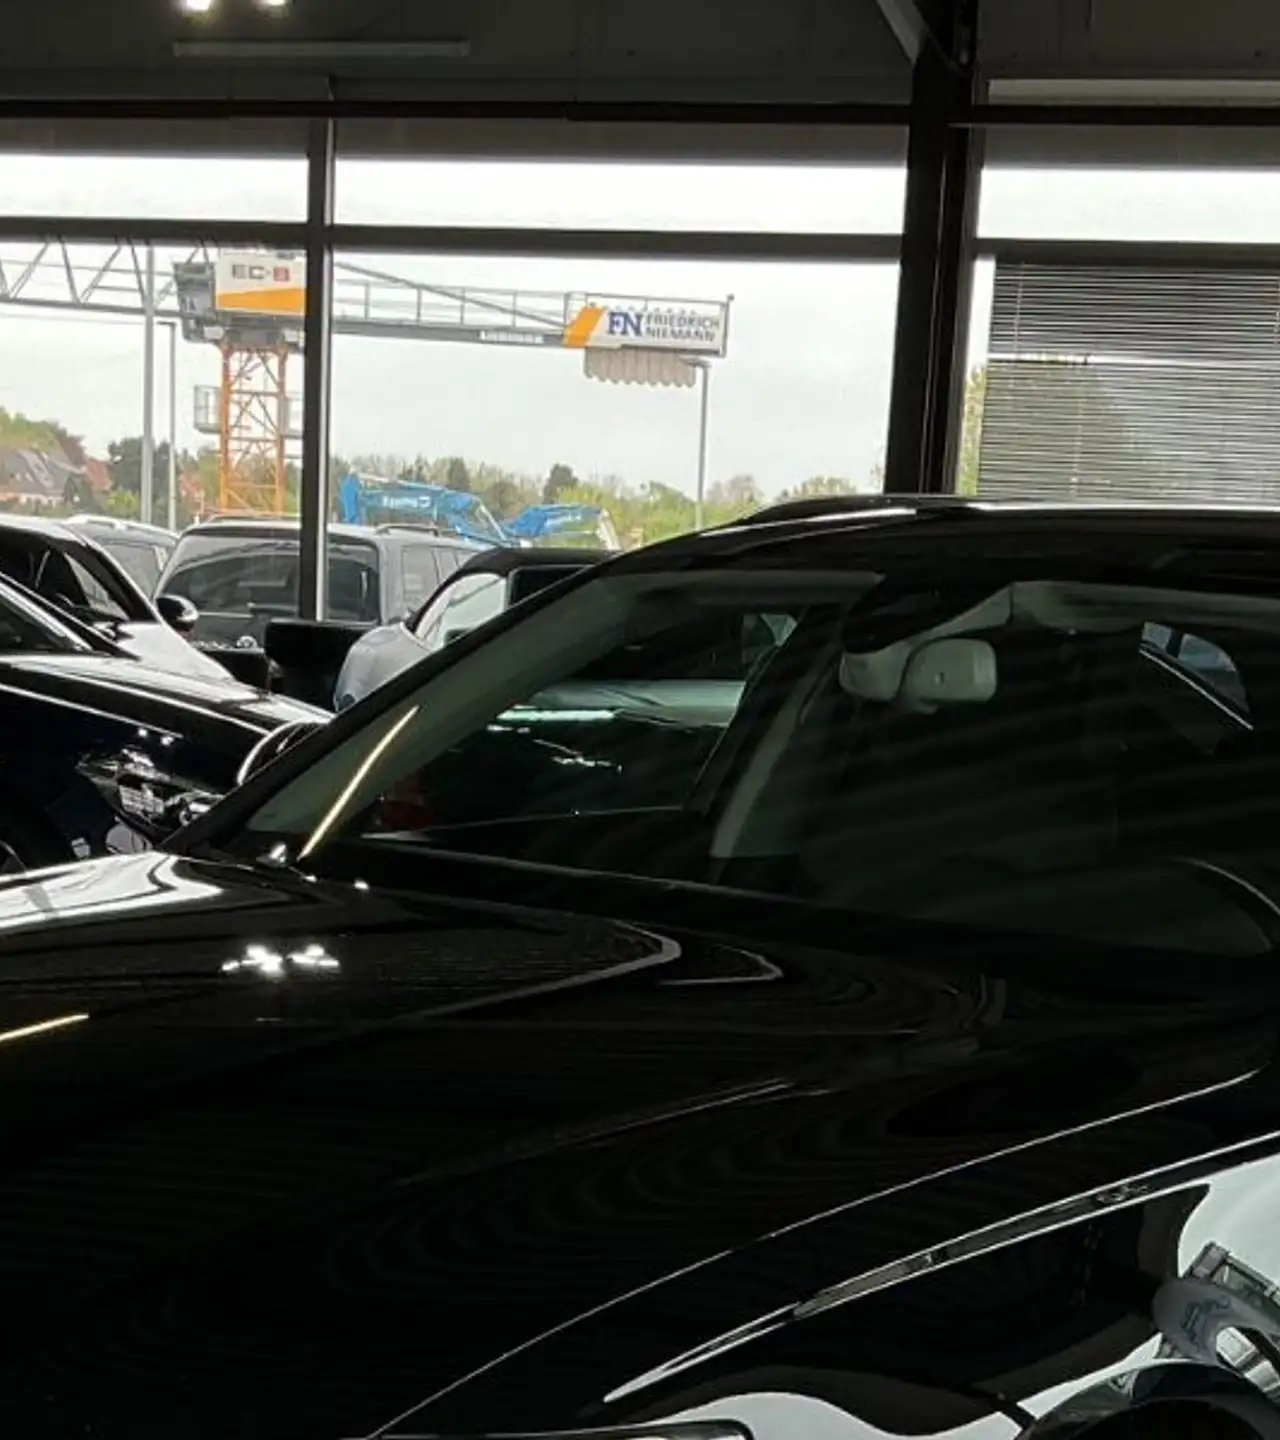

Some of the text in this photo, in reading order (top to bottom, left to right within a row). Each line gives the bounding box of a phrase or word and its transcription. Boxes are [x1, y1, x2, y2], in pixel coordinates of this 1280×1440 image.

[608, 311, 644, 337] FN
[645, 312, 719, 329] FRIEDRICH
[645, 327, 716, 342] NIEMANN
